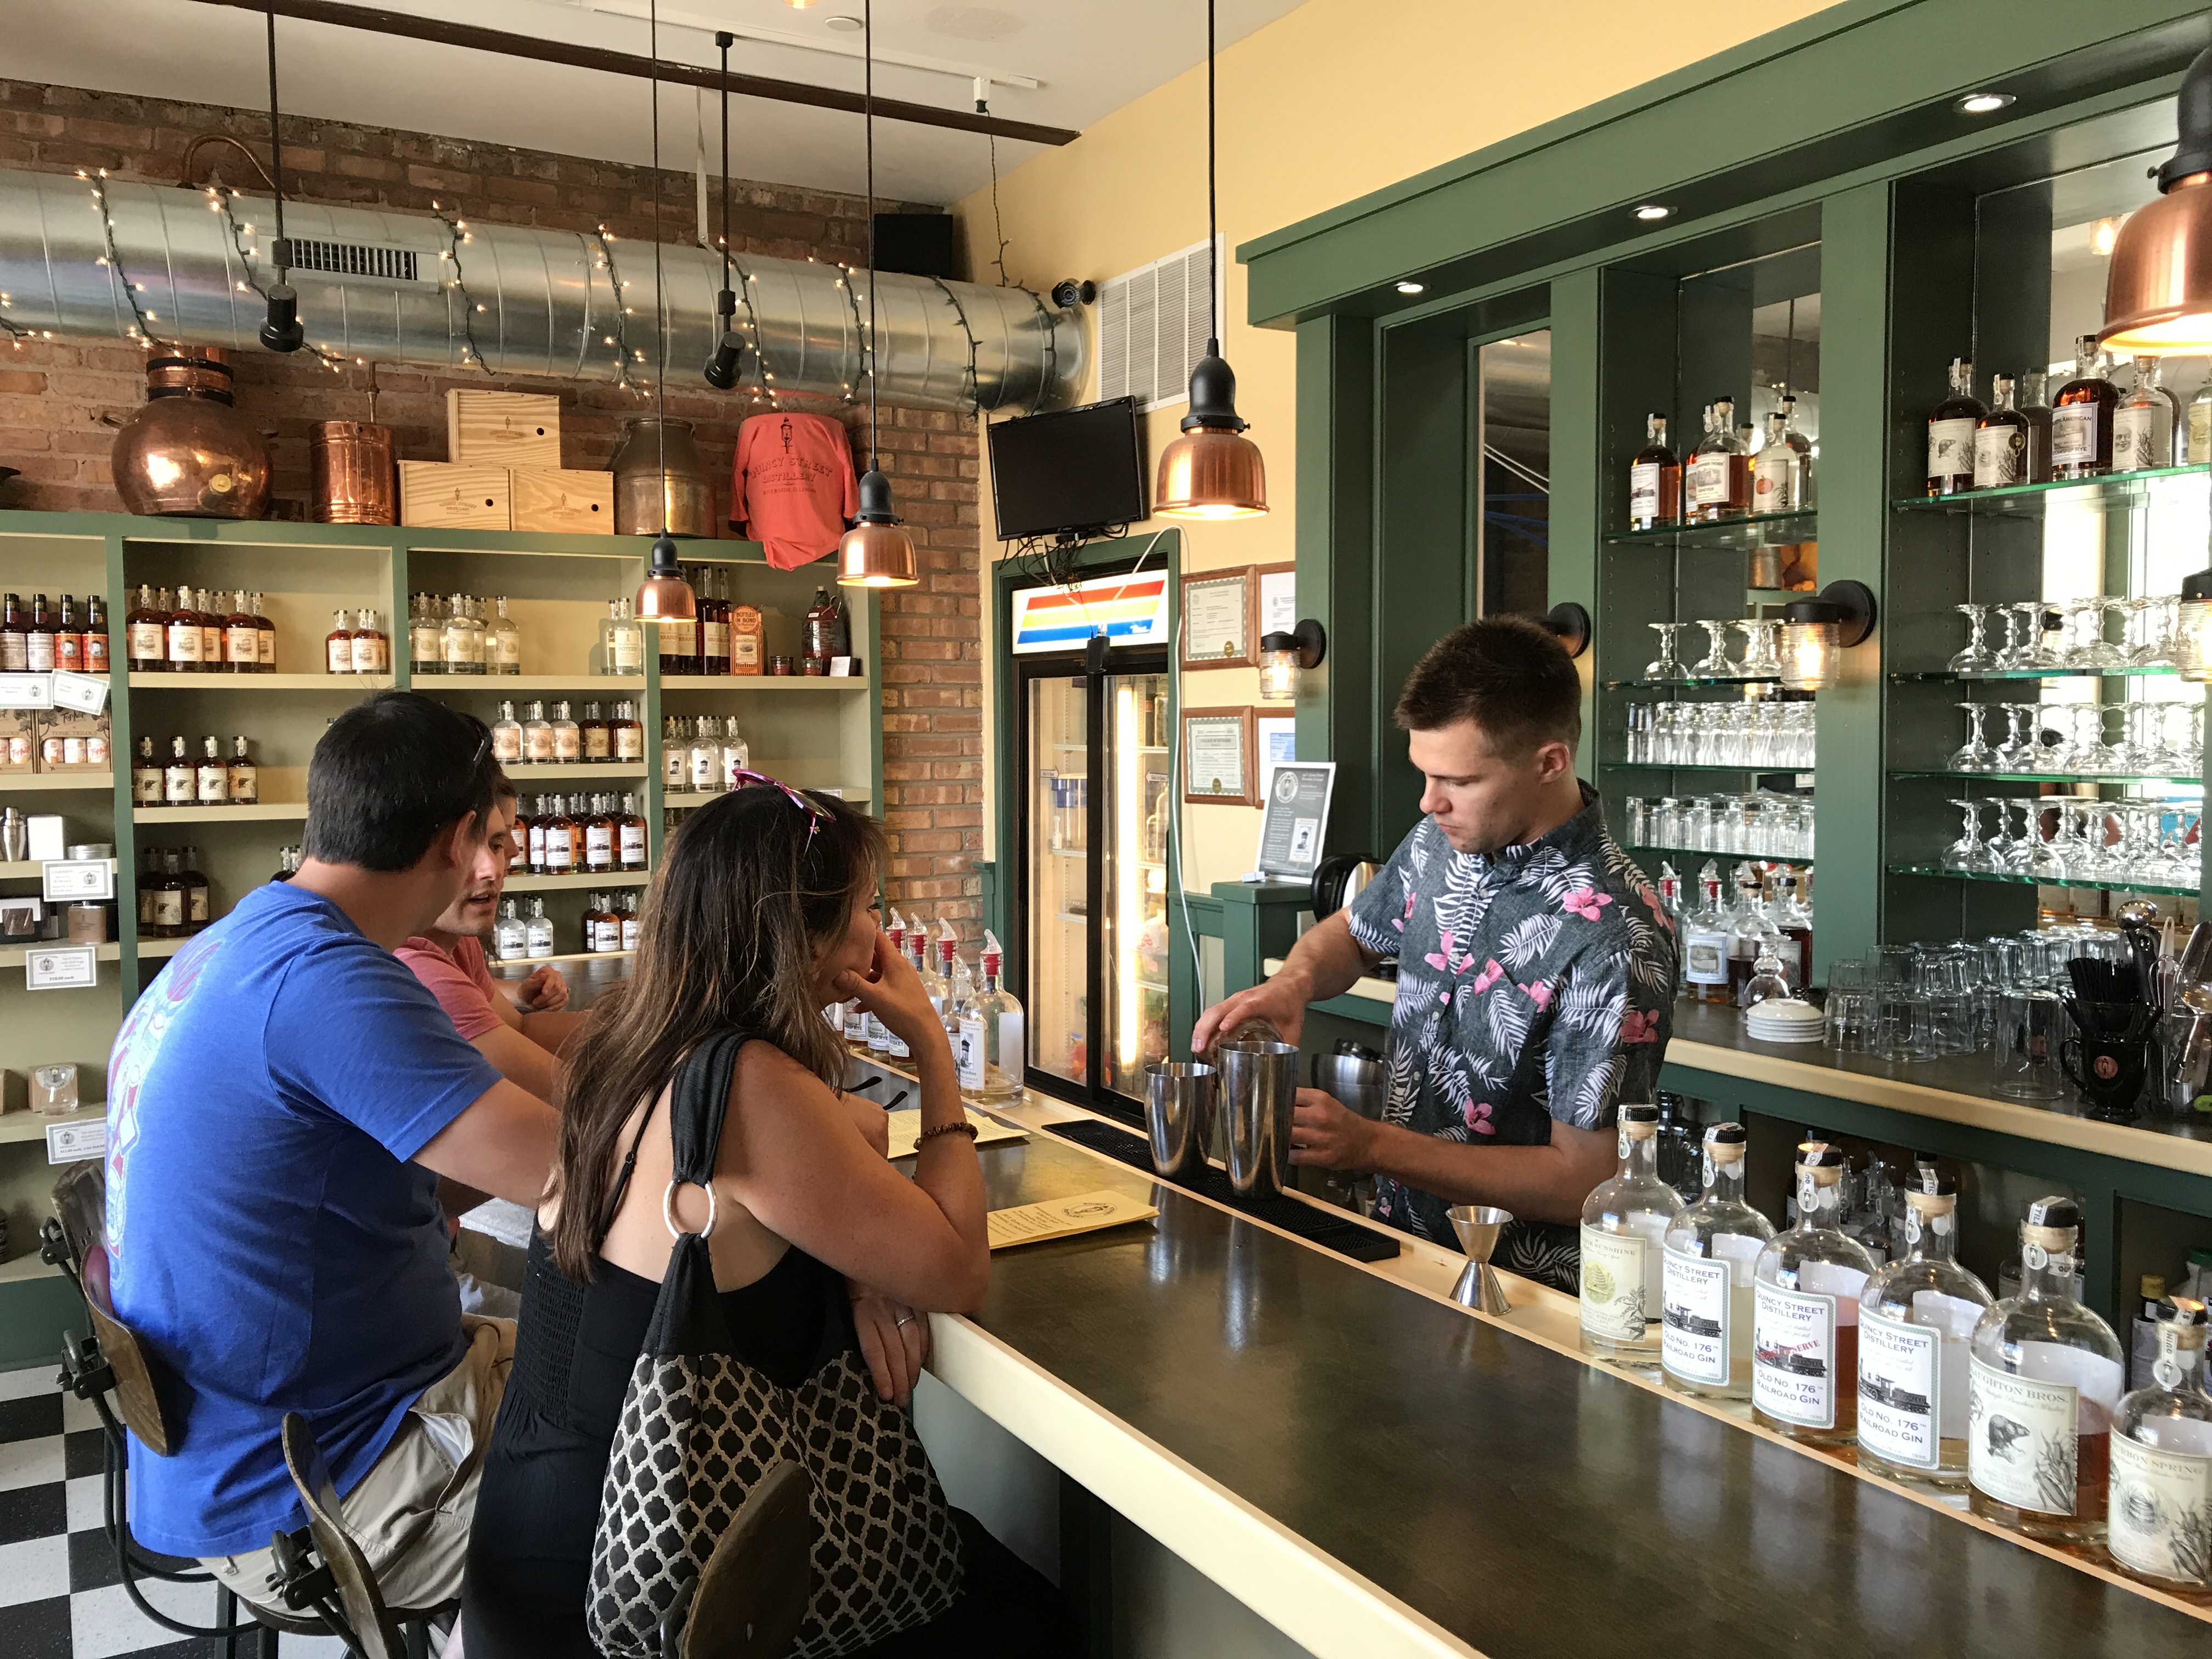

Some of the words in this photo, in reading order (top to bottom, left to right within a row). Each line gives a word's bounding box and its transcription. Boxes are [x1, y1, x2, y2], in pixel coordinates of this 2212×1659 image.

[763, 472, 816, 484] DISTILLERY
[789, 458, 832, 476] STREET
[1594, 1243, 1635, 1256] SUNSHINE
[1663, 1255, 1683, 1271] QUINCY
[1685, 1266, 1720, 1279] STREET
[1667, 1266, 1708, 1285] DISTILLERY
[1757, 1290, 1782, 1306] QUINCY
[1784, 1301, 1825, 1315] STREET
[1762, 1301, 1812, 1322] DISTILLERY
[1664, 1330, 1675, 1342] OLD
[1676, 1337, 1690, 1348] NO.
[1694, 1342, 1712, 1352] 176
[1859, 1318, 1883, 1337] QUINCY
[1886, 1331, 1928, 1348] STREET
[1864, 1330, 1915, 1355] DISTILLERY
[1663, 1338, 1695, 1359] RAILROAD
[1697, 1353, 1716, 1364] GIN
[1756, 1379, 1797, 1401] RAILROAD
[1799, 1395, 1820, 1405] GIN
[1758, 1369, 1773, 1382] OLD
[1774, 1376, 1791, 1389] NO.
[1796, 1383, 1816, 1393] 176
[2026, 1389, 2069, 1404] BROS.
[1859, 1412, 1899, 1437] RAILROAD
[1901, 1432, 1923, 1444] GIN
[1861, 1402, 1874, 1417] OLD
[1876, 1411, 1893, 1425] NO.
[1898, 1419, 1919, 1431] 176
